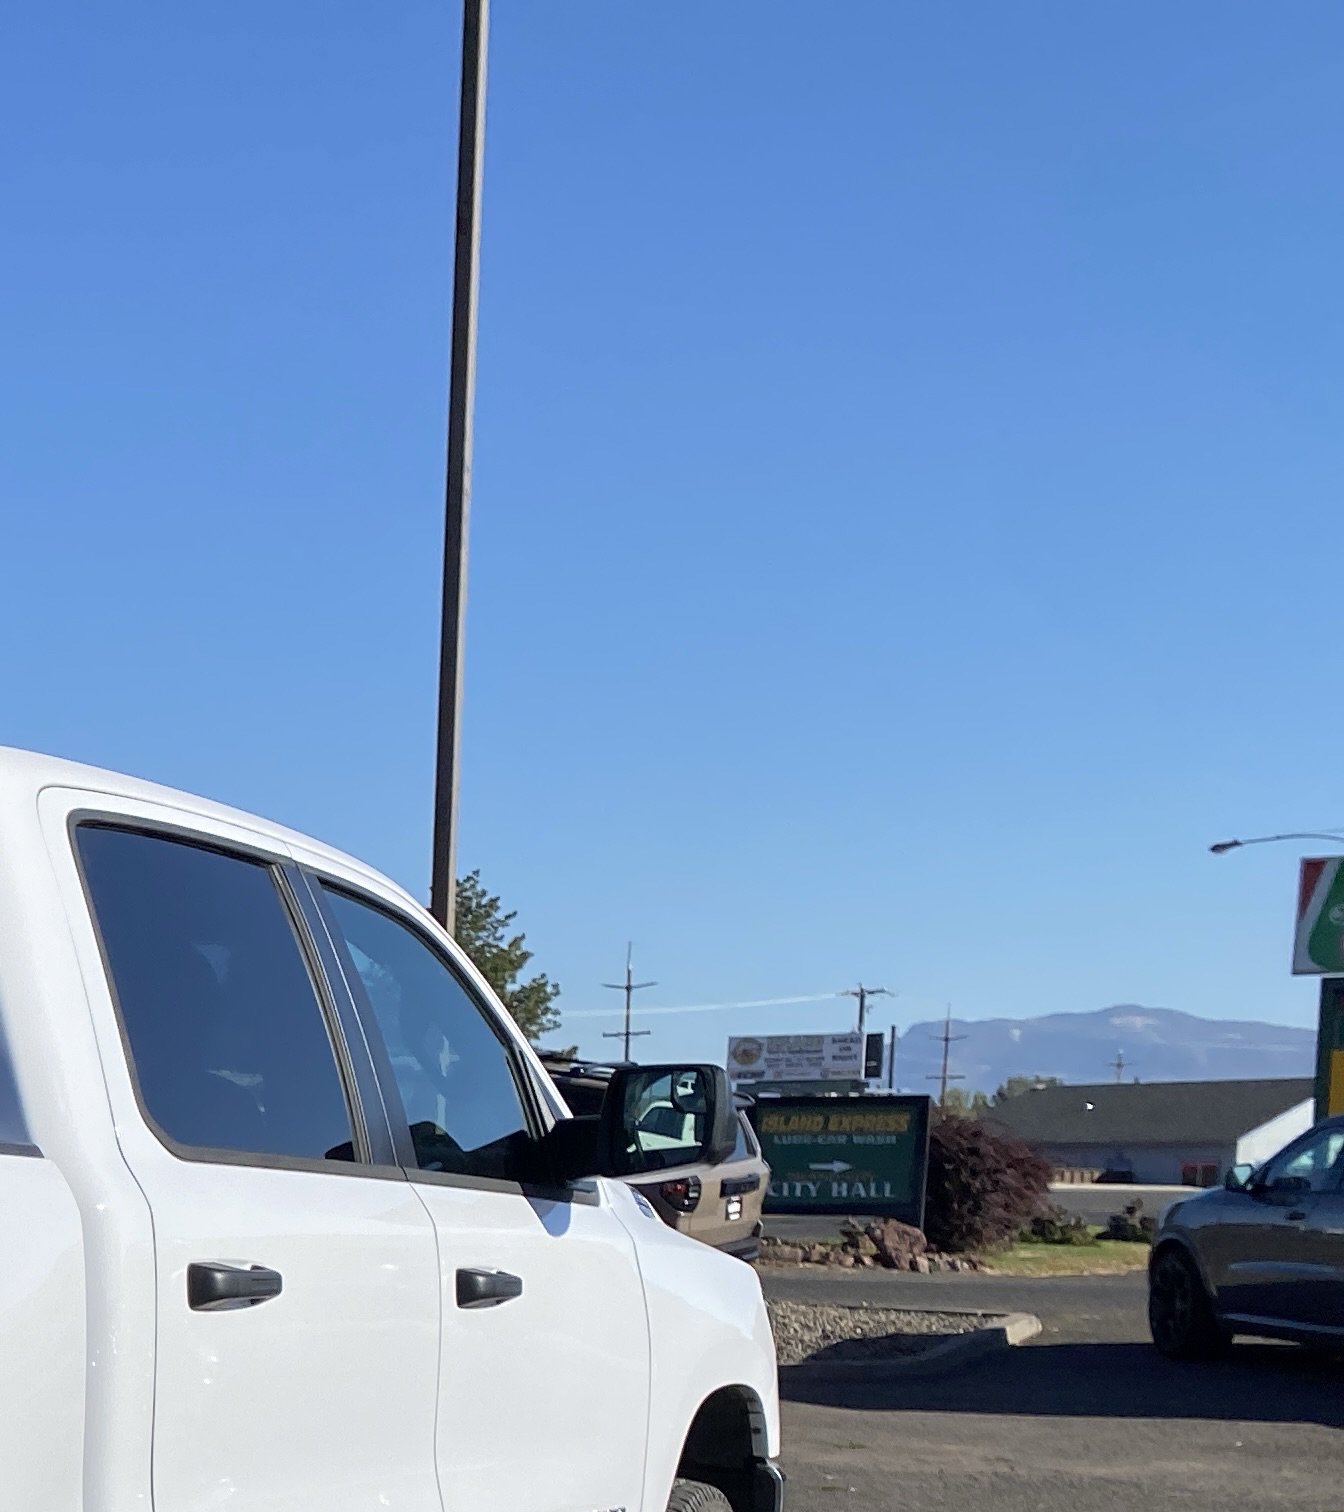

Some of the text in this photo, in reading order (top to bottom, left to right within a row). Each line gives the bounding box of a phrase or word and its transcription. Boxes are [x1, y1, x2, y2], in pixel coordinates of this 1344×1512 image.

[828, 1112, 911, 1132] EXPRESS
[852, 1134, 898, 1146] WASH
[767, 1180, 898, 1199] CITY HALL
